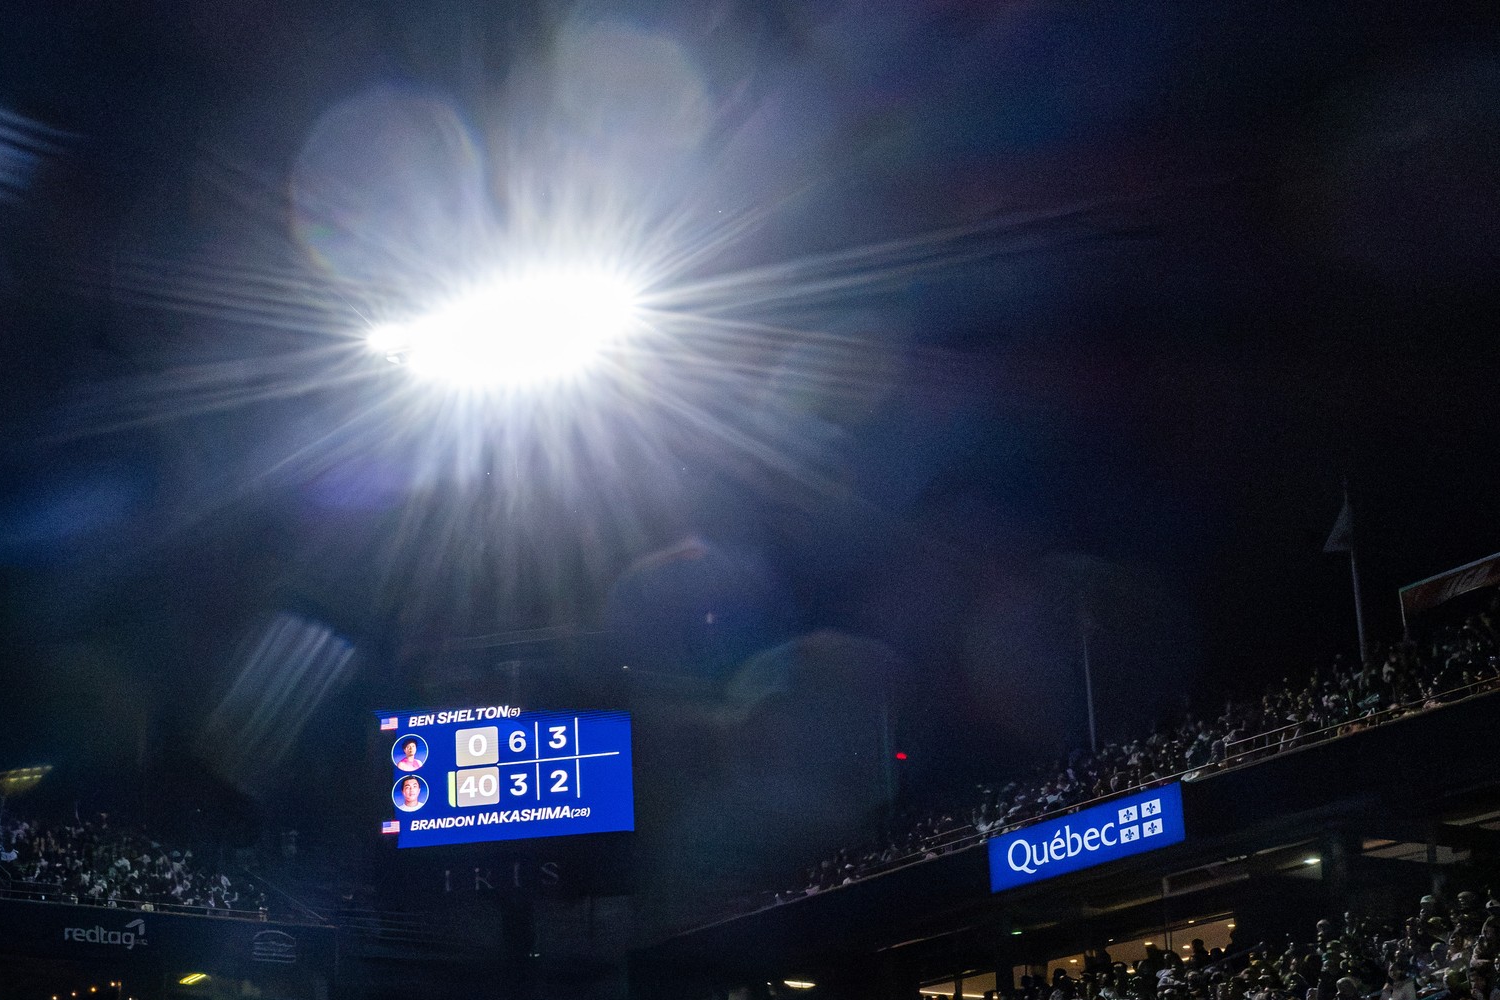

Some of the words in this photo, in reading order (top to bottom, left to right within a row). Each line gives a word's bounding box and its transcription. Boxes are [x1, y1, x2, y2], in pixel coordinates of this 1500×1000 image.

[408, 714, 435, 728] BEN
[468, 734, 488, 757] 0
[508, 730, 527, 753] 6
[549, 725, 567, 749] 3
[459, 774, 498, 799] 40
[510, 773, 528, 796] 3
[550, 770, 569, 793] 2
[410, 814, 476, 832] BRANDON
[1007, 822, 1118, 874] Québec
